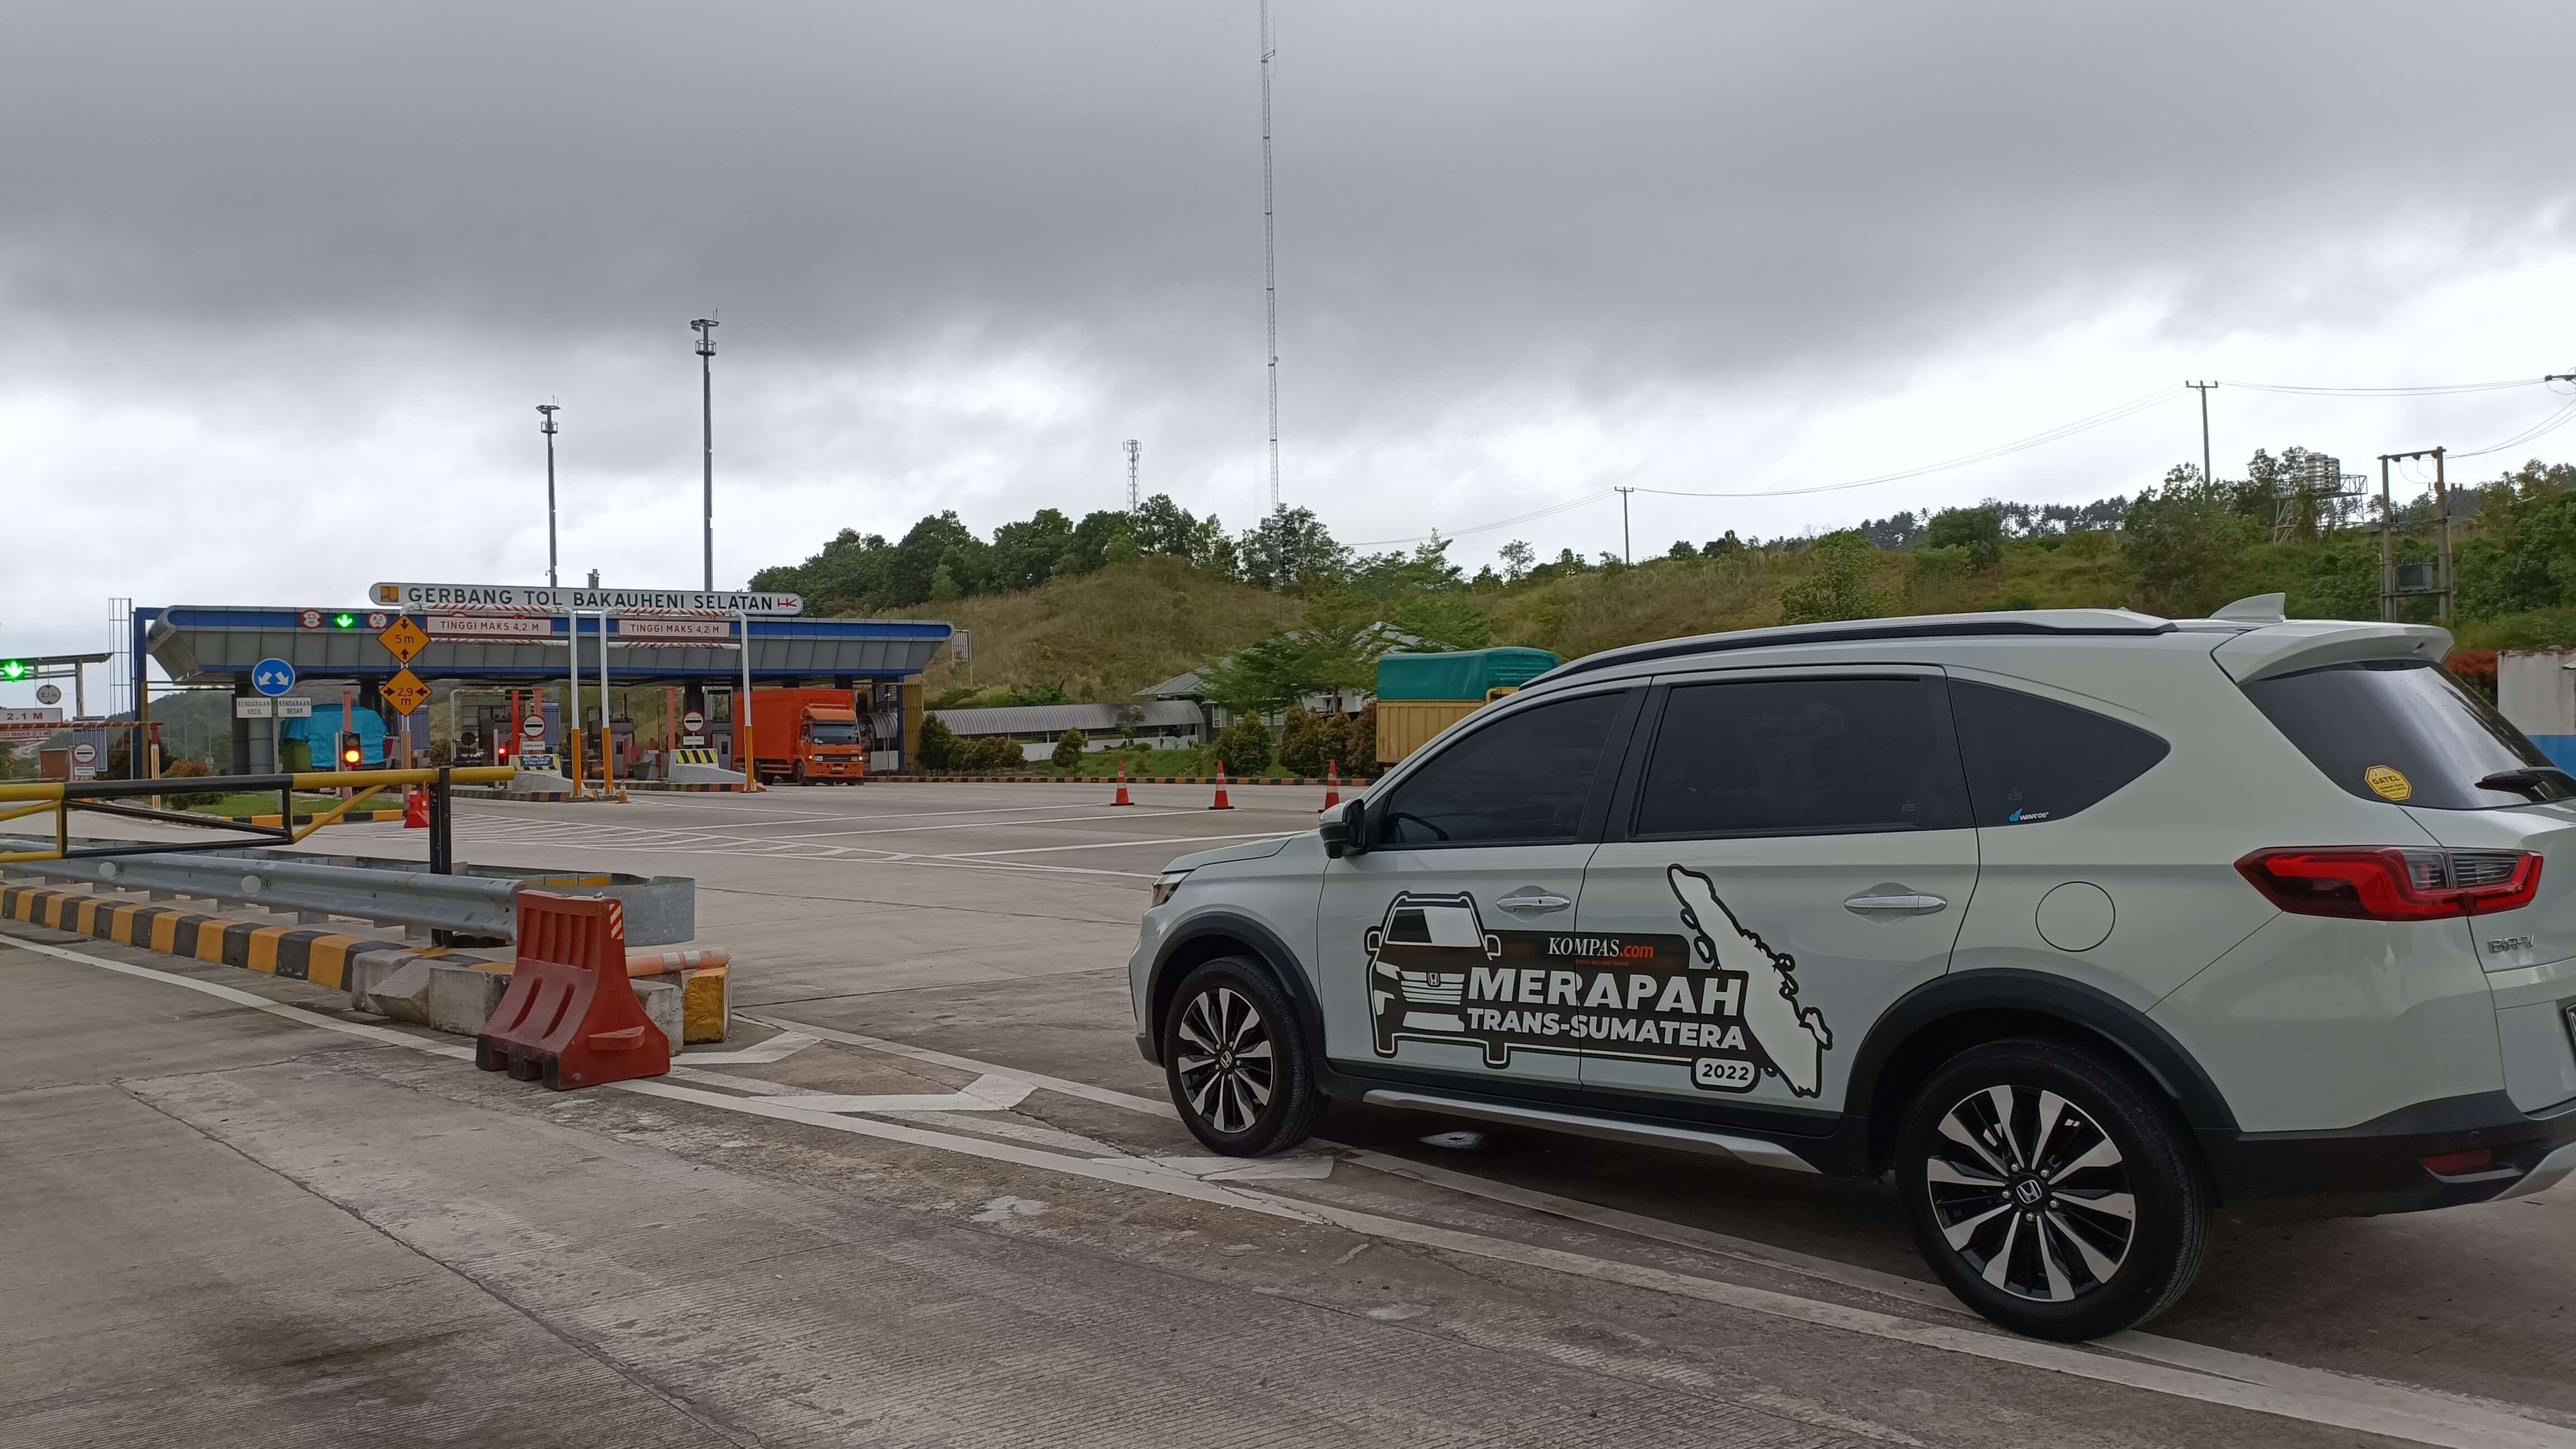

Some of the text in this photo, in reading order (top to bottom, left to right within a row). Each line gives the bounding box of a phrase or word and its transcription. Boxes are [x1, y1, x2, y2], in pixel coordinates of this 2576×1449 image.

[408, 588, 513, 605] GERBANG
[523, 590, 562, 605] TOL
[573, 592, 685, 608] BAKAUHENI
[694, 595, 772, 610] SELATAN
[441, 621, 476, 629] TINGGI
[513, 623, 528, 632] 4,2
[397, 688, 413, 697] 2,9
[2372, 775, 2400, 784] GATEL
[1547, 937, 1654, 958] KOMPAS.com
[2488, 935, 2535, 953] BR-V
[1468, 967, 1741, 1016] MERAPAH
[1467, 1008, 1746, 1050] TRANS-SUMATERA
[1702, 1064, 1749, 1081] 2022
